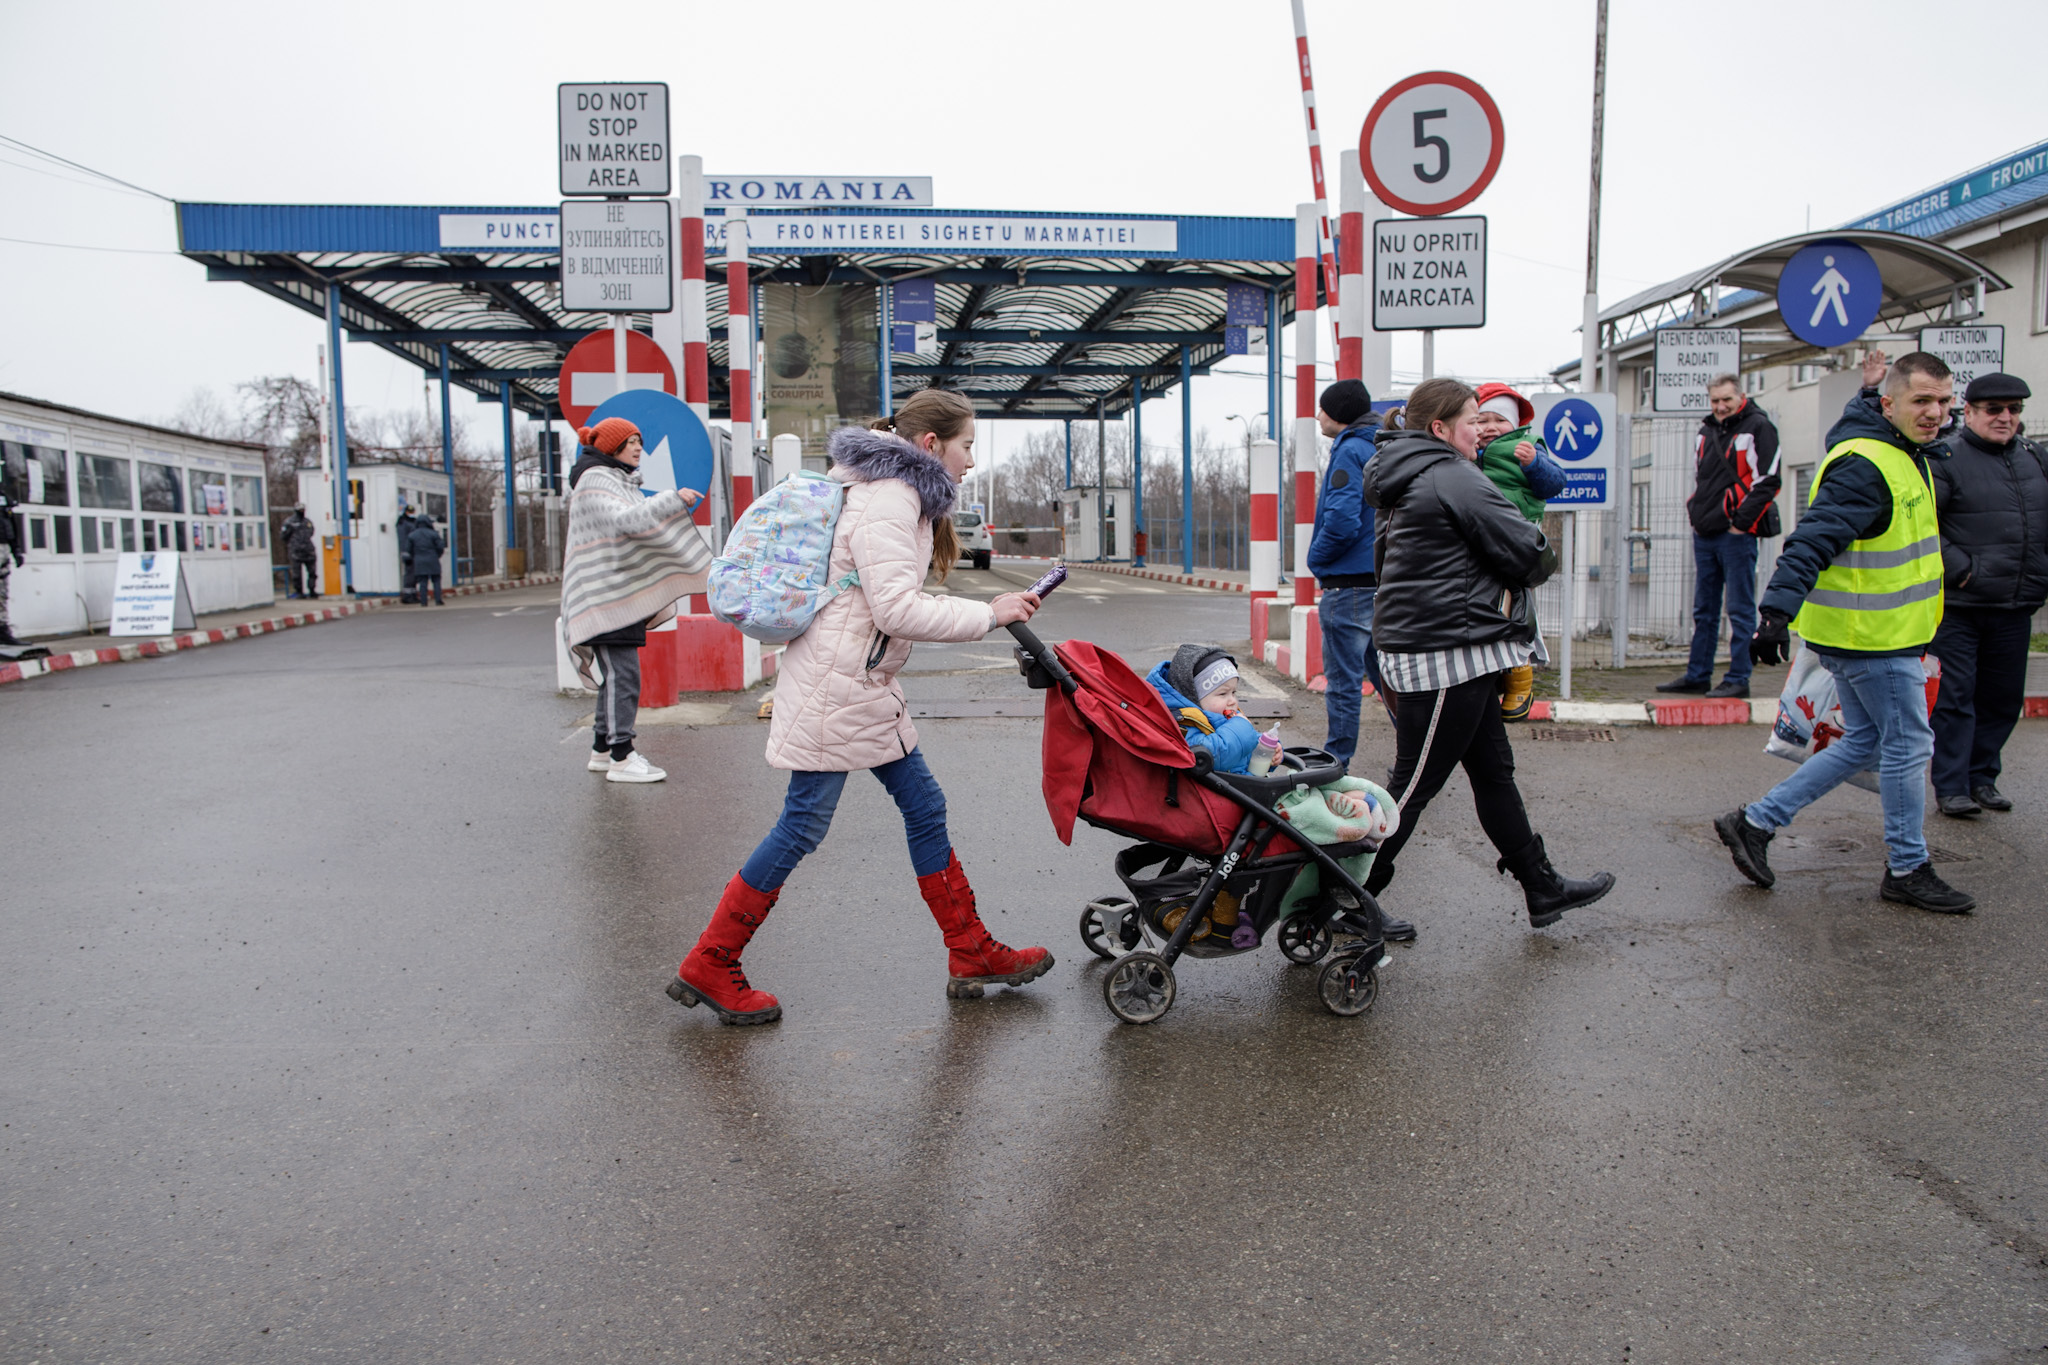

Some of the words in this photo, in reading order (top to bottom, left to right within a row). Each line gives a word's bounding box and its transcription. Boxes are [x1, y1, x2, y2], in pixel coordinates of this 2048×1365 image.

[577, 93, 603, 111] DO
[610, 92, 648, 111] NOT
[588, 118, 638, 136] STOP
[565, 143, 581, 162] IN
[588, 143, 663, 162] MARKED
[1413, 108, 1450, 184] 5
[588, 168, 640, 187] AREA
[607, 205, 625, 223] НЕ
[1885, 190, 1950, 227] TRECERE
[1961, 183, 1972, 201] A
[487, 223, 554, 239] PUNCT
[566, 228, 664, 248] ЗУПИНЯЙТЕСЬ
[777, 223, 904, 240] FRONTIEREI
[1380, 235, 1405, 254] NU
[1413, 232, 1479, 252] OPRITI
[568, 257, 575, 274] В
[581, 255, 664, 277] ВІДМІЧЕНІЙ
[1388, 262, 1405, 280] IN
[1413, 260, 1467, 279] ZONA
[600, 283, 632, 301] ЗОНІ
[1380, 288, 1474, 308] MARCATA
[1660, 332, 1694, 346] ATENTIE
[1697, 331, 1738, 346] CONTROL
[1938, 330, 1988, 345] ATTENTION
[1677, 352, 1719, 366] RADIATII
[1965, 350, 2002, 364] CONTROL
[1657, 373, 1690, 387] TRECETI
[1567, 473, 1596, 481] BLIGATORIU
[1598, 472, 1605, 480] LA
[1554, 487, 1599, 499] EAPTA
[1202, 665, 1237, 690] adida
